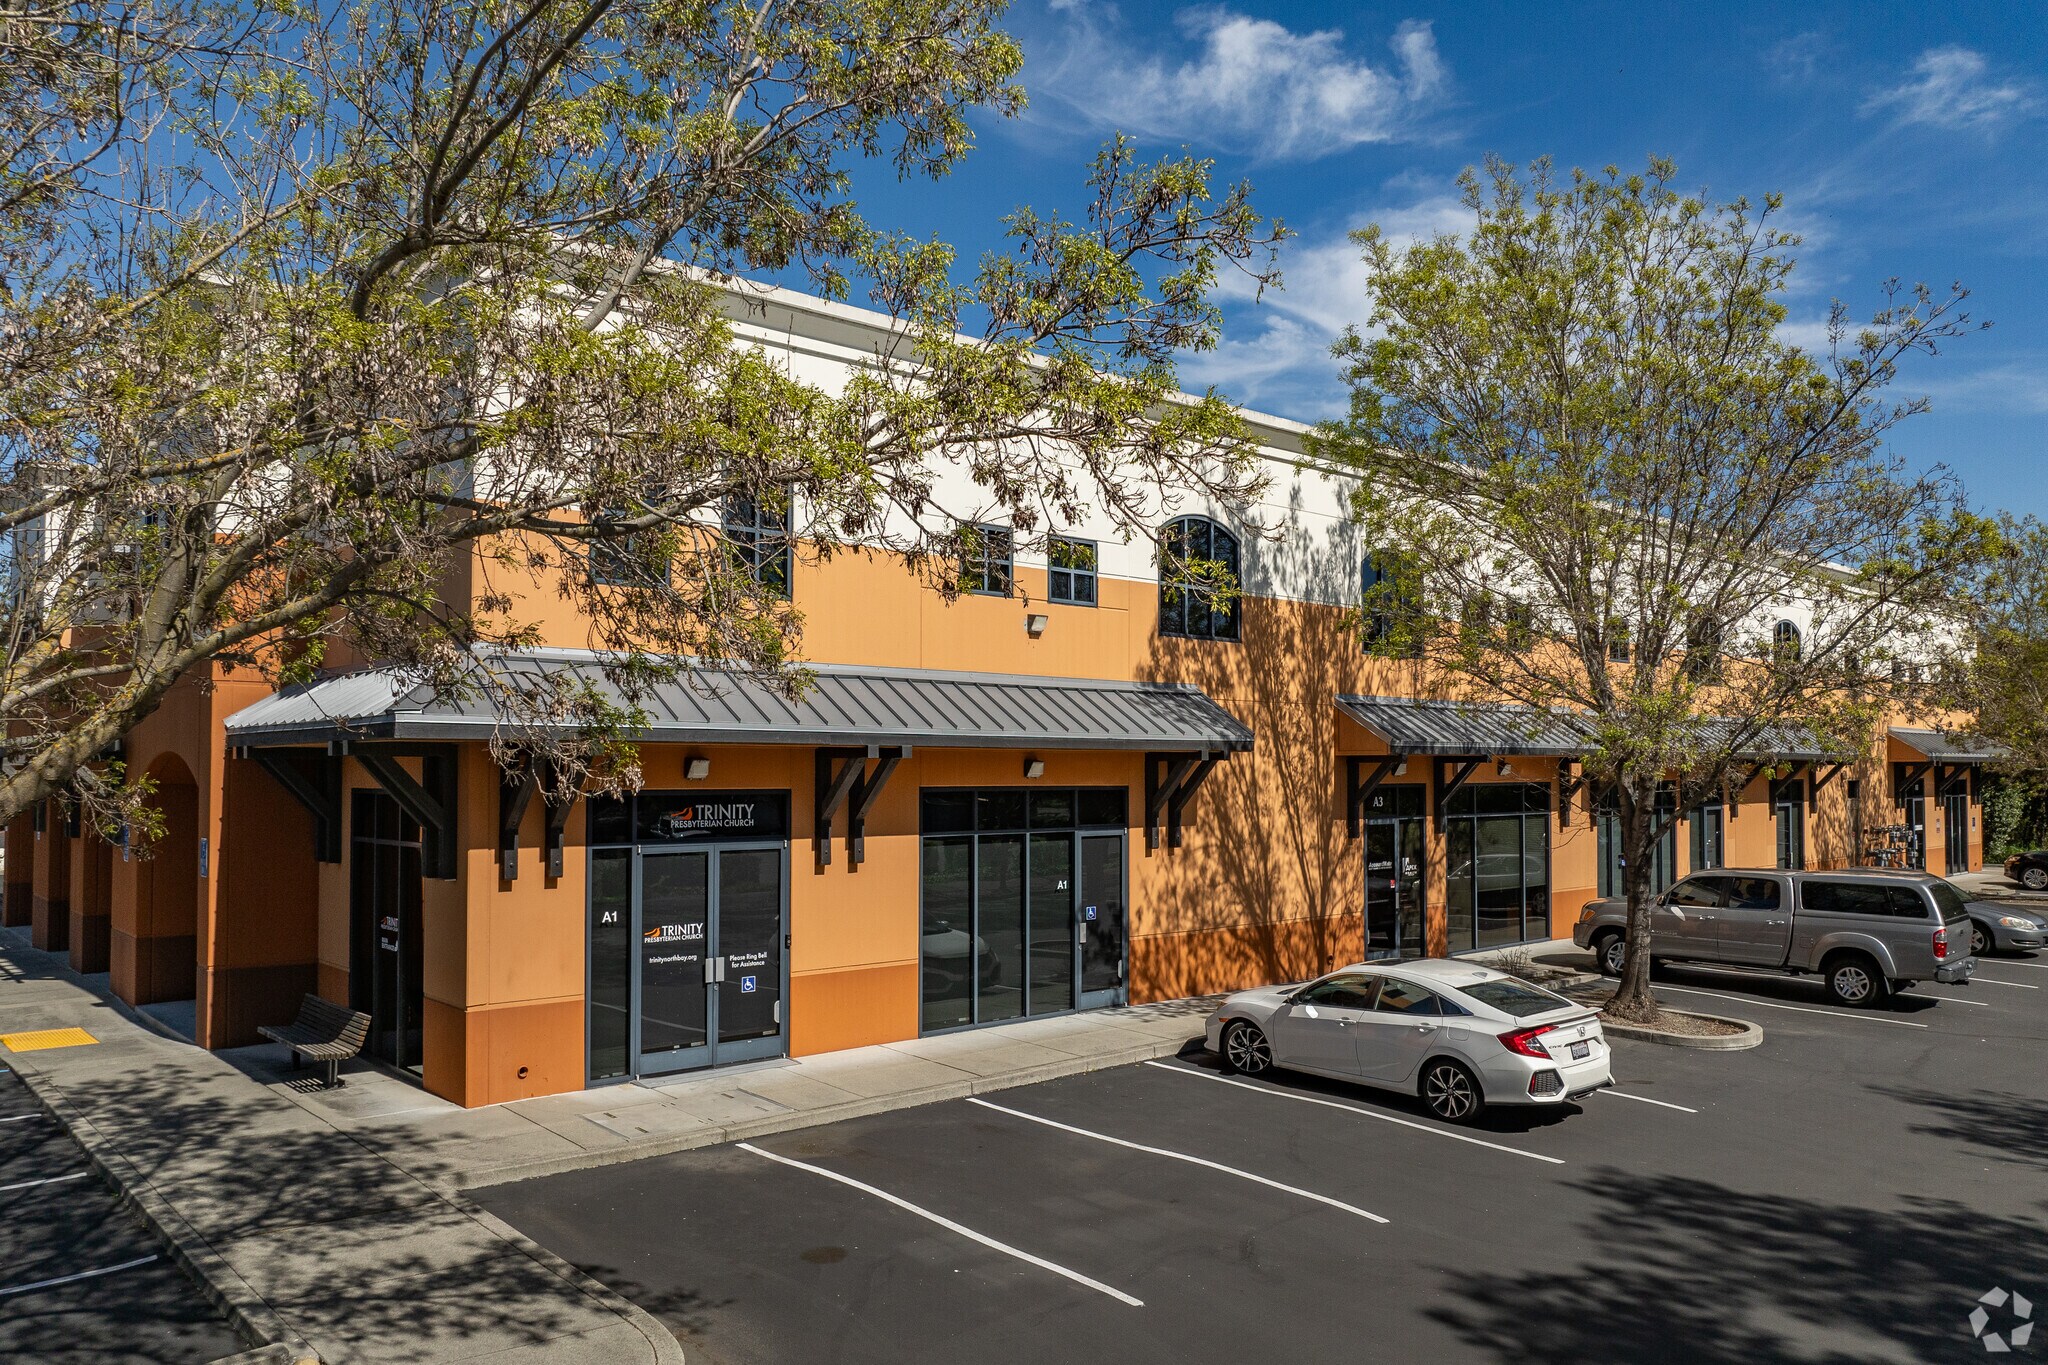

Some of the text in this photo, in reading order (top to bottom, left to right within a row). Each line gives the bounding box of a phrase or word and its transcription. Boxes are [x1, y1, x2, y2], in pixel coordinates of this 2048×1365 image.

[1373, 796, 1383, 807] A3
[695, 803, 754, 819] TRINITY
[670, 818, 754, 829] PRESBYTERIAN CHURCH
[1057, 880, 1068, 890] A1
[601, 910, 618, 923] A1
[661, 922, 704, 937] TRINITY
[644, 933, 704, 944] PRESBYTERIAN CHURCH
[729, 954, 746, 962] Please
